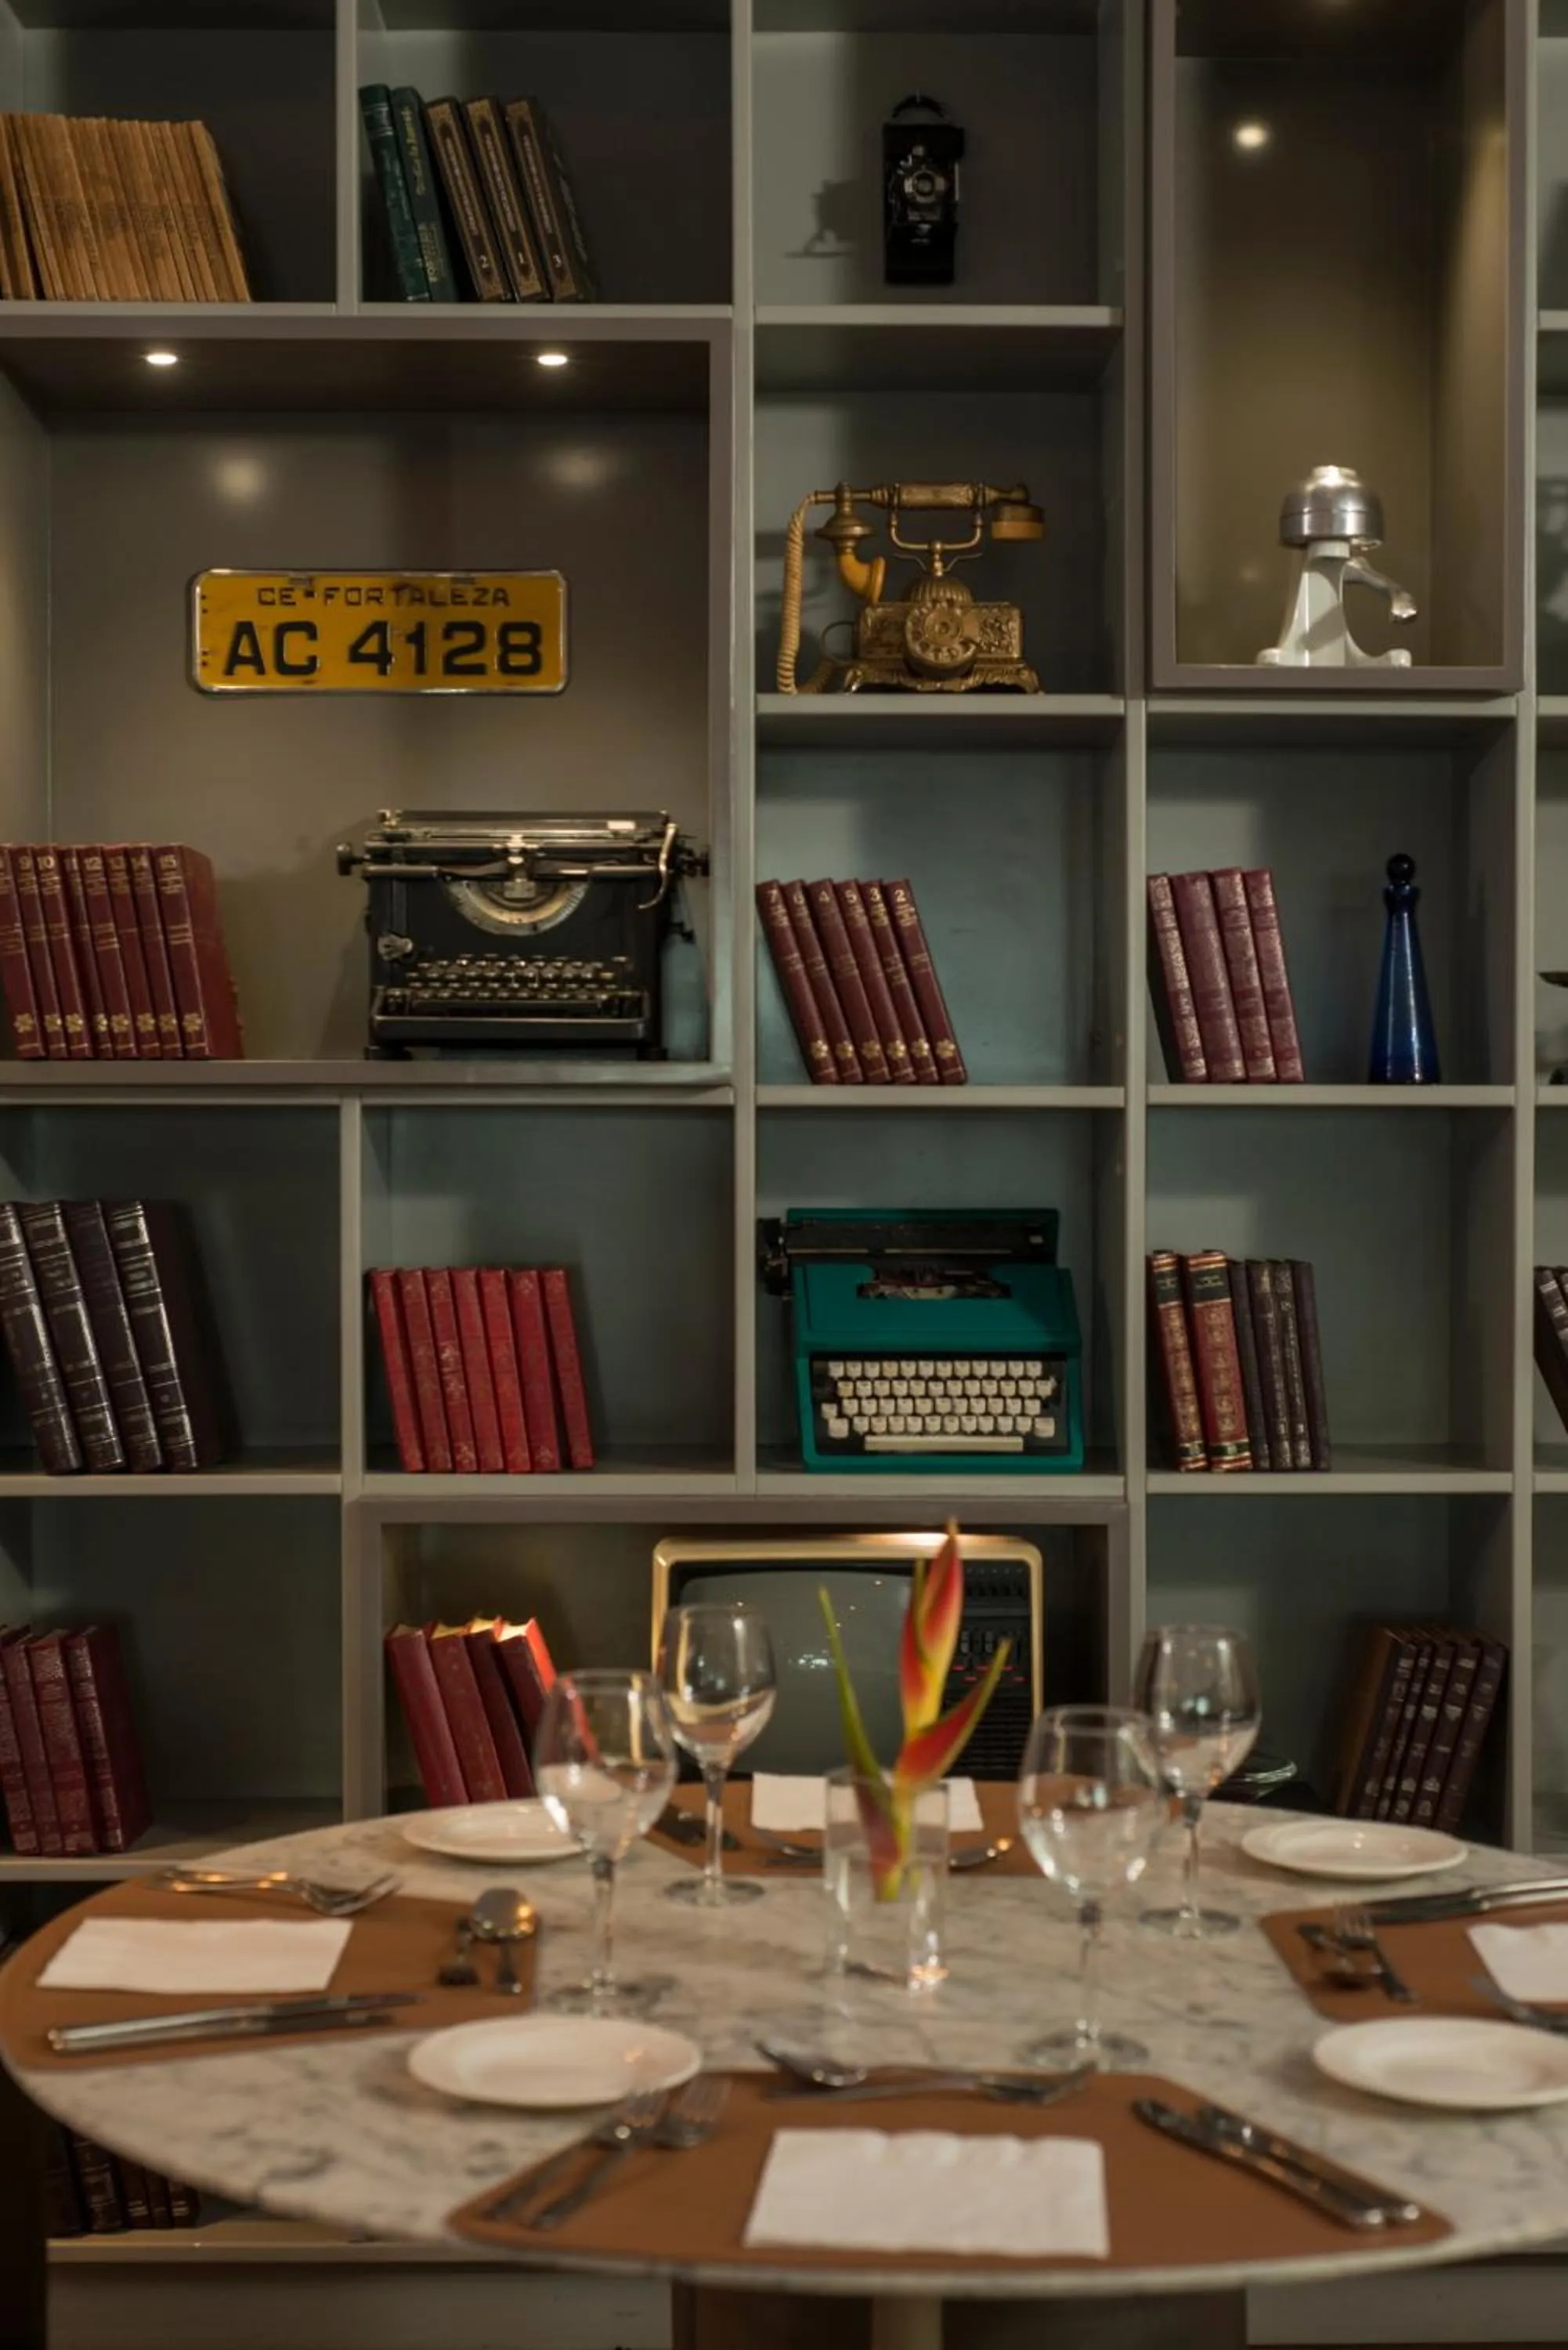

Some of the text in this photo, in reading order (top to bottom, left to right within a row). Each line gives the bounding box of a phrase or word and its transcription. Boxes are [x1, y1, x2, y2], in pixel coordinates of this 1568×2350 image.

[479, 255, 489, 269] 2
[518, 251, 525, 264] 1
[553, 255, 562, 268] 3
[224, 620, 542, 676] AC 4128
[37, 855, 56, 870] 10
[84, 855, 102, 870] 12
[159, 854, 177, 869] 15
[768, 889, 778, 903] 7
[818, 890, 830, 902] 4
[845, 889, 857, 903] 5
[869, 886, 880, 902] 3
[894, 889, 906, 902] 2
